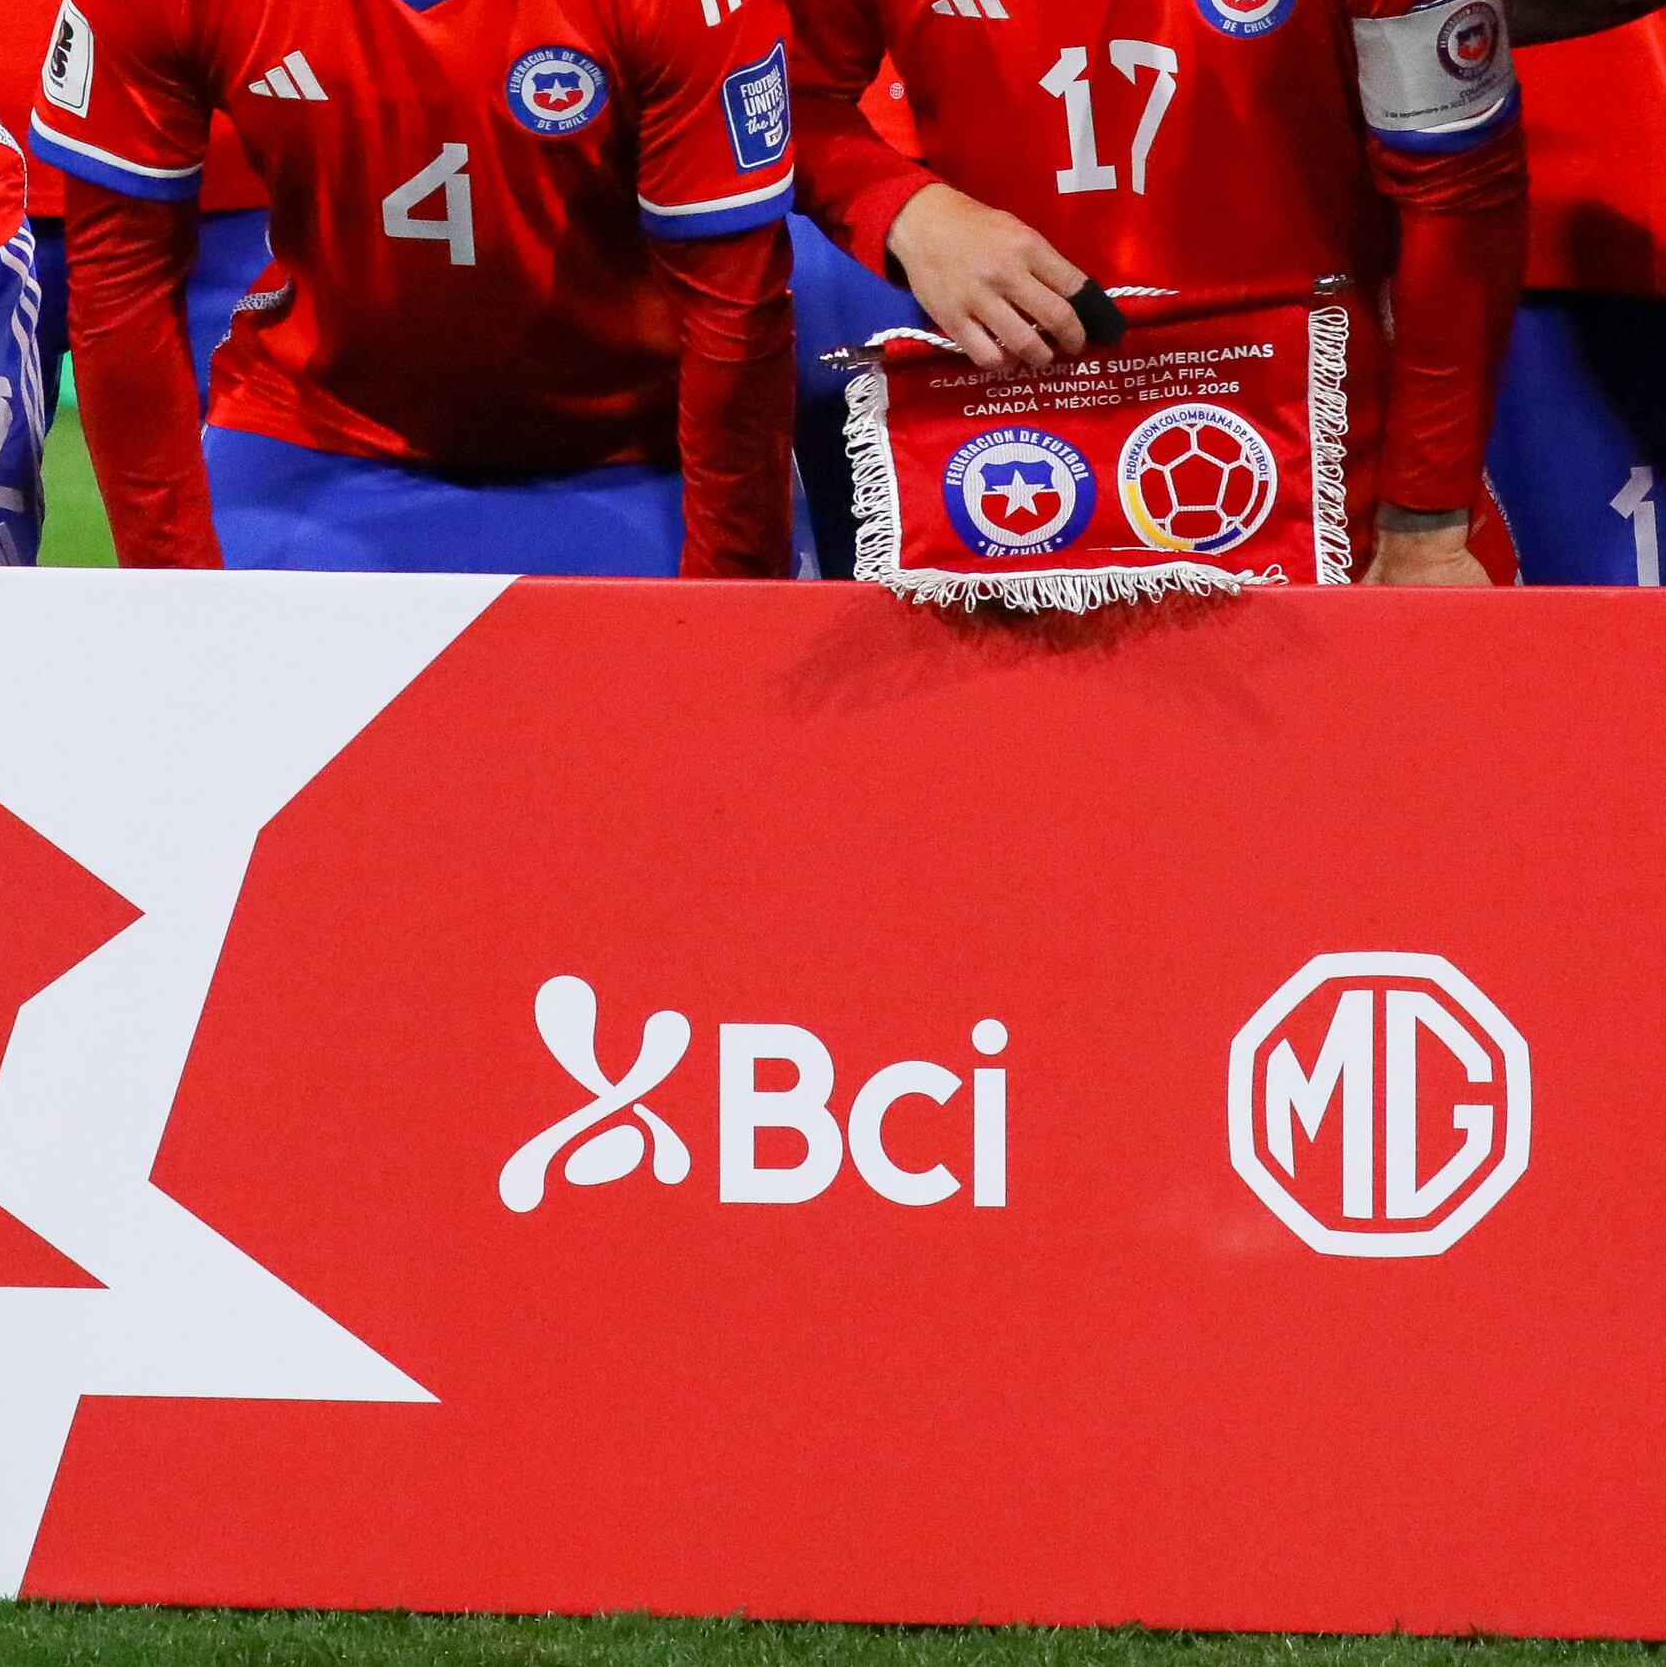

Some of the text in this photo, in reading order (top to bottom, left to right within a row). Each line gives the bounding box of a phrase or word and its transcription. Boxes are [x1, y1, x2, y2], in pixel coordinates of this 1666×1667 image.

[1222, 16, 1275, 33] DE CHILE
[561, 51, 576, 62] DE
[536, 112, 588, 131] DE CHILE
[745, 116, 769, 135] the
[1038, 39, 1180, 195] 17
[382, 142, 476, 266] 4
[1107, 343, 1274, 373] SUDAMERICANAS
[985, 367, 1217, 398] COPA MUNDIAL DE LA FIFA
[963, 397, 1038, 417] CANADÁ
[1055, 393, 1120, 410] MÉXICO
[1138, 383, 1193, 402] EE.UU.
[1197, 381, 1240, 395] 2026
[1159, 410, 1233, 429] COLOMBIANA
[1232, 425, 1248, 439] DE
[946, 429, 1089, 486] FEDERACION DE FUTBOL
[719, 1018, 1008, 1209] Bci
[1265, 988, 1495, 1221] MG
